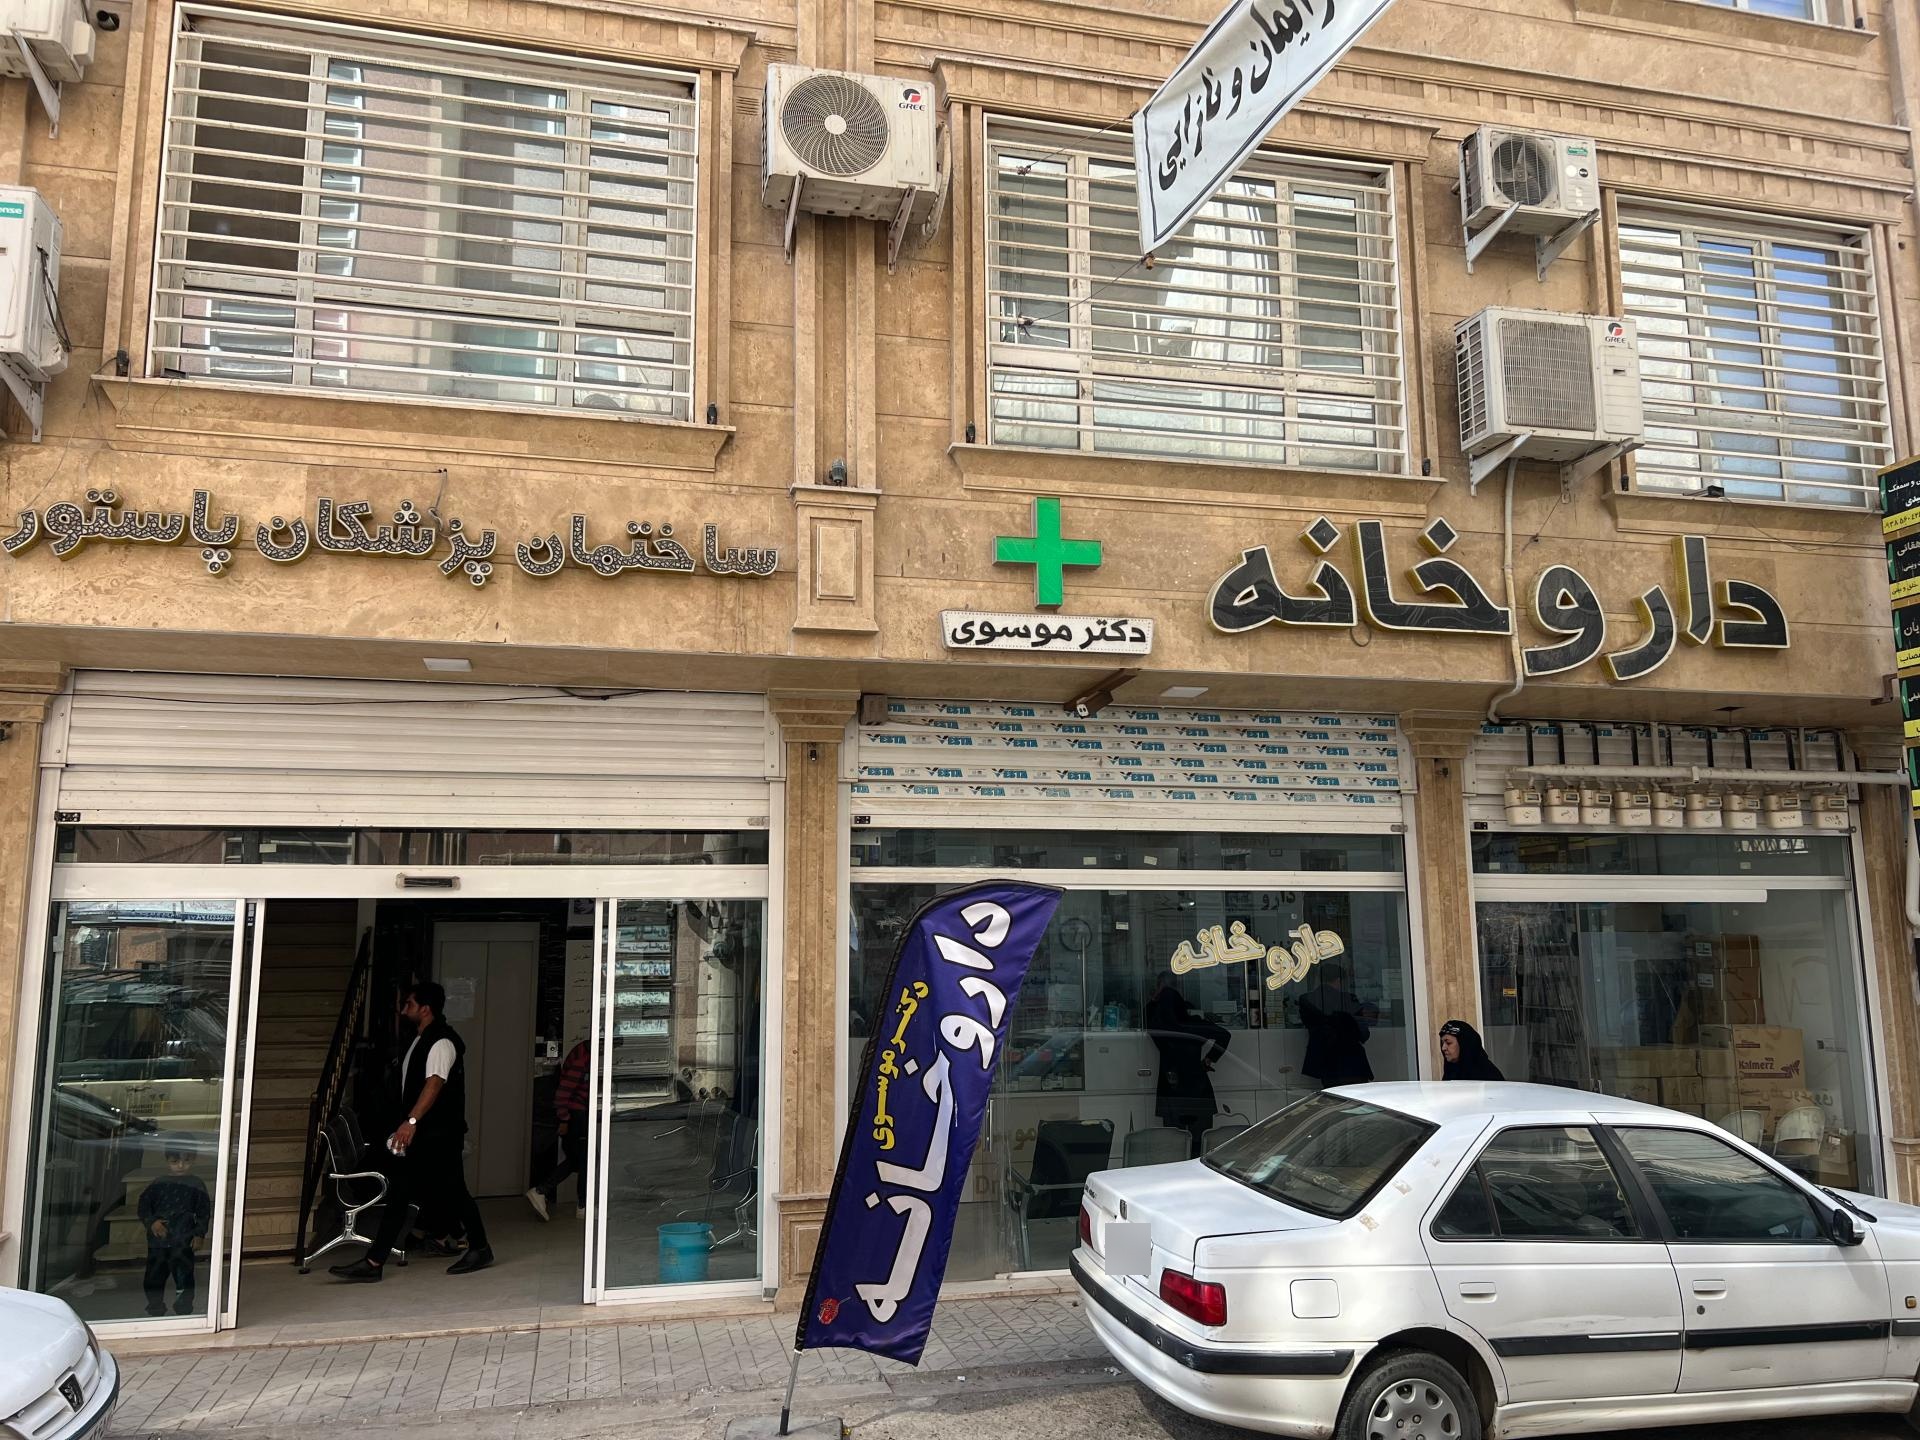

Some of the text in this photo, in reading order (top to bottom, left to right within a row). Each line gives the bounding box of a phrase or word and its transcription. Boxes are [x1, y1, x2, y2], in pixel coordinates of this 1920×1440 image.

[1226, 67, 1243, 120] و
[898, 102, 927, 112] GREE
[1158, 66, 1222, 191] نازایی
[0, 207, 22, 215] nse
[1604, 335, 1627, 345] GREE
[1, 487, 780, 588] ساختمان پزشکان پاستور
[1205, 514, 1792, 681] داروخانه
[951, 619, 1147, 649] دکتر موسوی
[935, 704, 972, 714] VESTA
[999, 705, 1035, 716] VESTA
[1125, 710, 1159, 720] VESTA
[1186, 711, 1221, 722] VESTA
[1249, 714, 1281, 724] VESTA
[921, 718, 959, 729] VESTA
[1309, 716, 1341, 725] VESTA
[987, 721, 1023, 731] VESTA
[1051, 723, 1086, 733] VESTA
[1113, 725, 1148, 735] VESTA
[1175, 726, 1209, 736] VESTA
[1236, 728, 1269, 738] VESTA
[1296, 730, 1329, 739] VESTA
[1354, 731, 1388, 741] VESTA
[866, 733, 907, 744] VESTA
[936, 735, 973, 745] VESTA
[1001, 737, 1038, 747] VESTA
[1066, 739, 1102, 749] VESTA
[1130, 741, 1165, 751] VESTA
[1193, 742, 1227, 752] VESTA
[1254, 744, 1288, 754] VESTA
[1315, 746, 1349, 756] VESTA
[1107, 756, 1142, 766] VESTA
[1170, 758, 1204, 767] VESTA
[1232, 759, 1267, 769] VESTA
[1293, 760, 1327, 770] VESTA
[1354, 762, 1387, 771] VESTA
[925, 767, 963, 777] VESTA
[992, 769, 1028, 778] VESTA
[1056, 770, 1091, 780] VESTA
[1120, 771, 1155, 781] VESTA
[1183, 773, 1218, 782] VESTA
[1245, 774, 1279, 784] VESTA
[1306, 776, 1340, 785] VESTA
[1366, 777, 1398, 786] VESTA
[902, 784, 939, 794] VESTA
[968, 785, 1005, 796] VESTA
[1034, 787, 1070, 797] VESTA
[1098, 788, 1134, 798] VESTA
[1161, 789, 1196, 800] VESTA
[1223, 791, 1257, 800] VESTA
[1284, 793, 1317, 802] VESTA
[1342, 793, 1375, 803] VESTA
[1171, 920, 1345, 990] داروخانه
[872, 981, 929, 1150] دکتر موسوی
[855, 901, 1011, 1323] داروخانه
